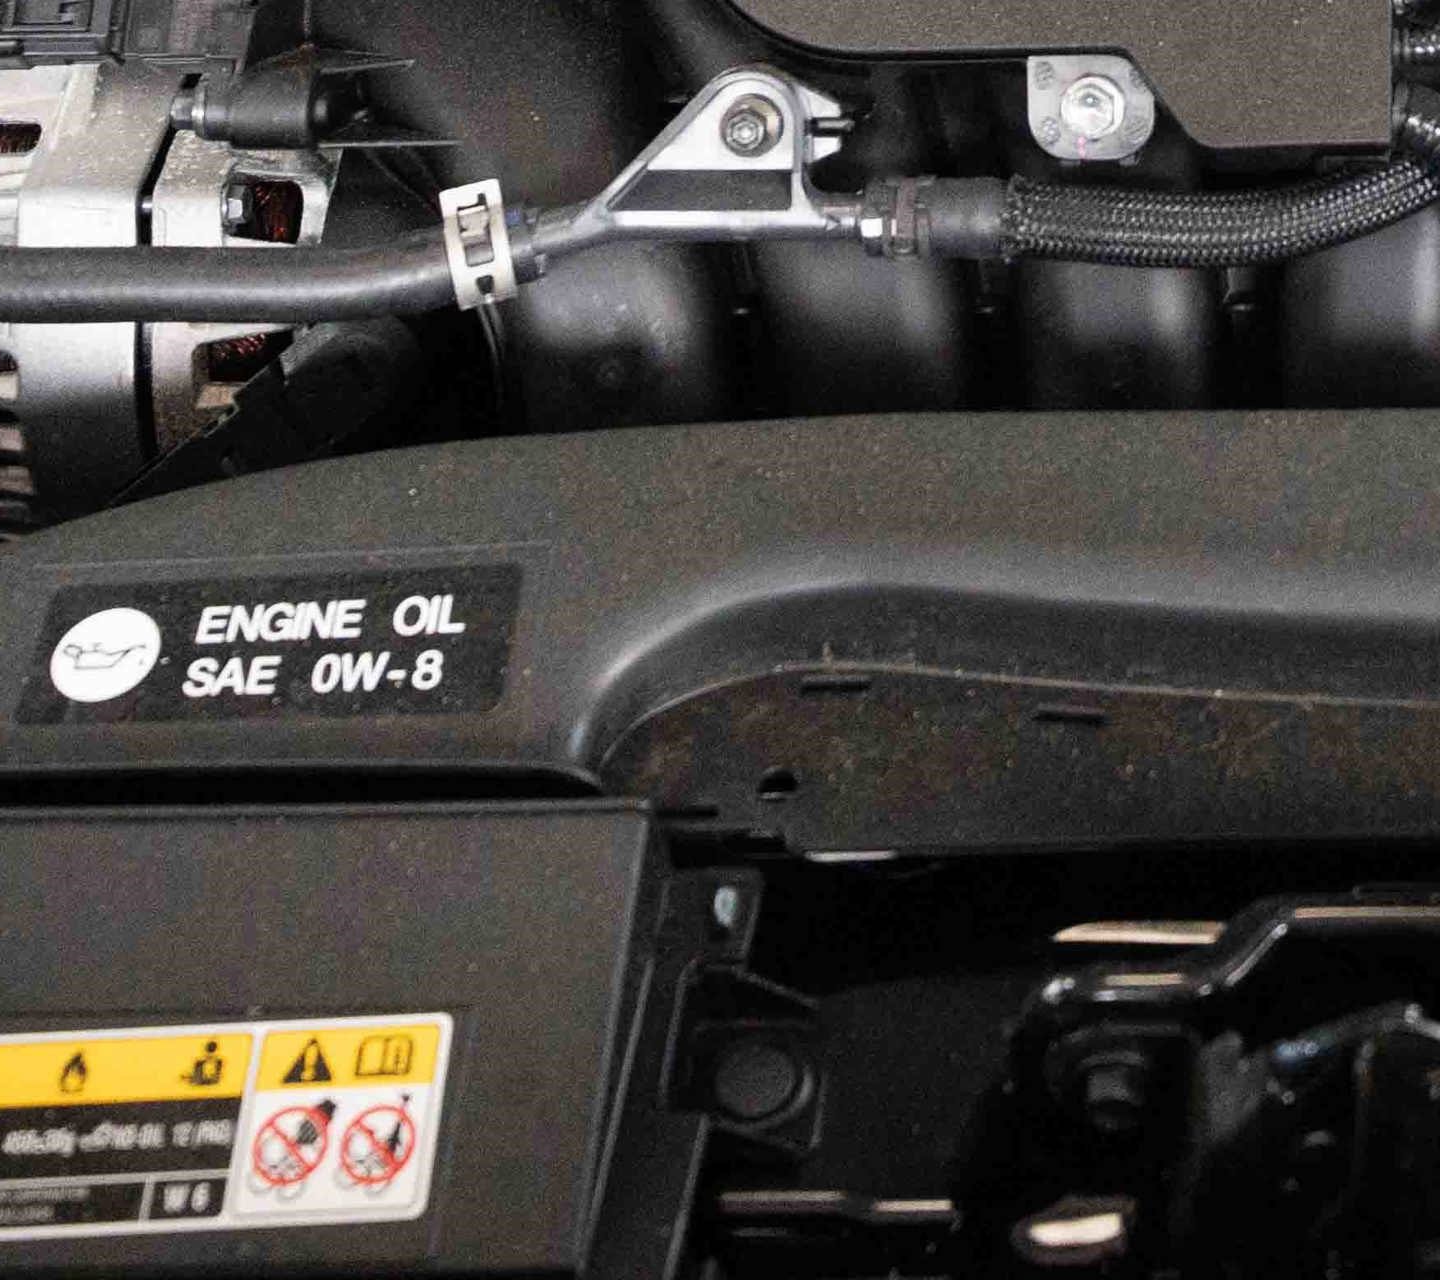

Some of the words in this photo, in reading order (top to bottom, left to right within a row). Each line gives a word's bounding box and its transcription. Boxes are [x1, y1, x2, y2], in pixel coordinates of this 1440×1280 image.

[194, 598, 367, 645] ENGINE
[392, 593, 467, 638] OIL
[181, 655, 282, 698] SAE
